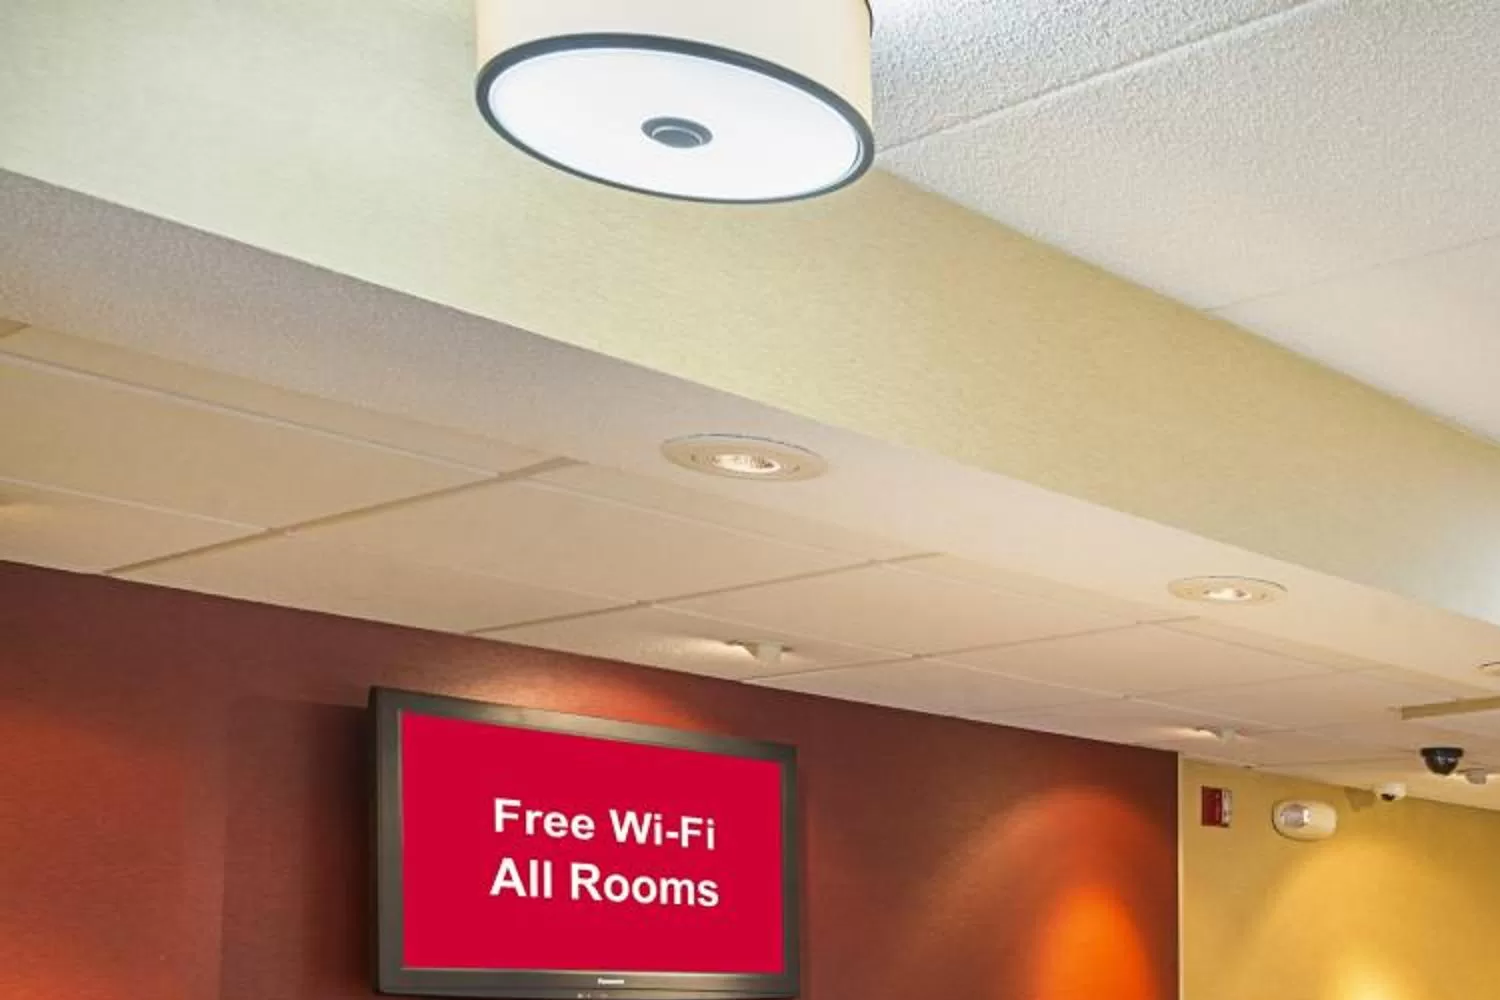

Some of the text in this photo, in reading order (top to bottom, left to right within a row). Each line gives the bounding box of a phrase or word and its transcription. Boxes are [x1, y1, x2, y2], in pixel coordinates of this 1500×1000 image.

[494, 797, 715, 850] Free Wi-Fi
[489, 857, 719, 907] All Rooms
